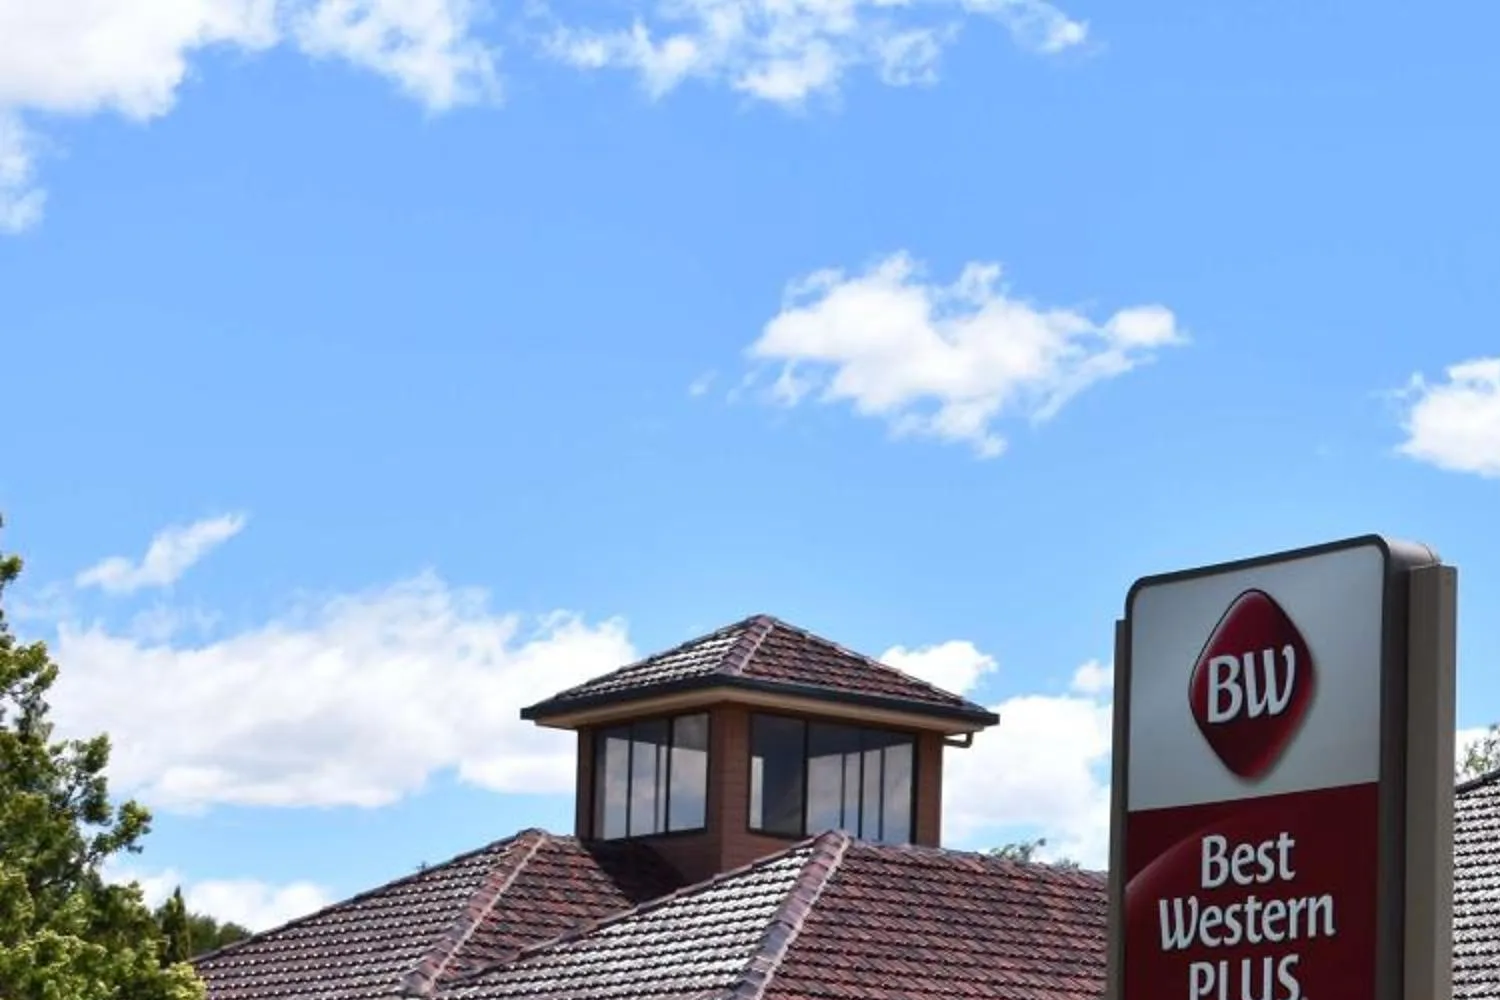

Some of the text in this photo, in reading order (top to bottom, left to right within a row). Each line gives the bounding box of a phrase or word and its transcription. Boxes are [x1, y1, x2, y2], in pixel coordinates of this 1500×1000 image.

[1207, 643, 1296, 724] BW
[1201, 831, 1297, 889] Best
[1158, 893, 1337, 951] Western
